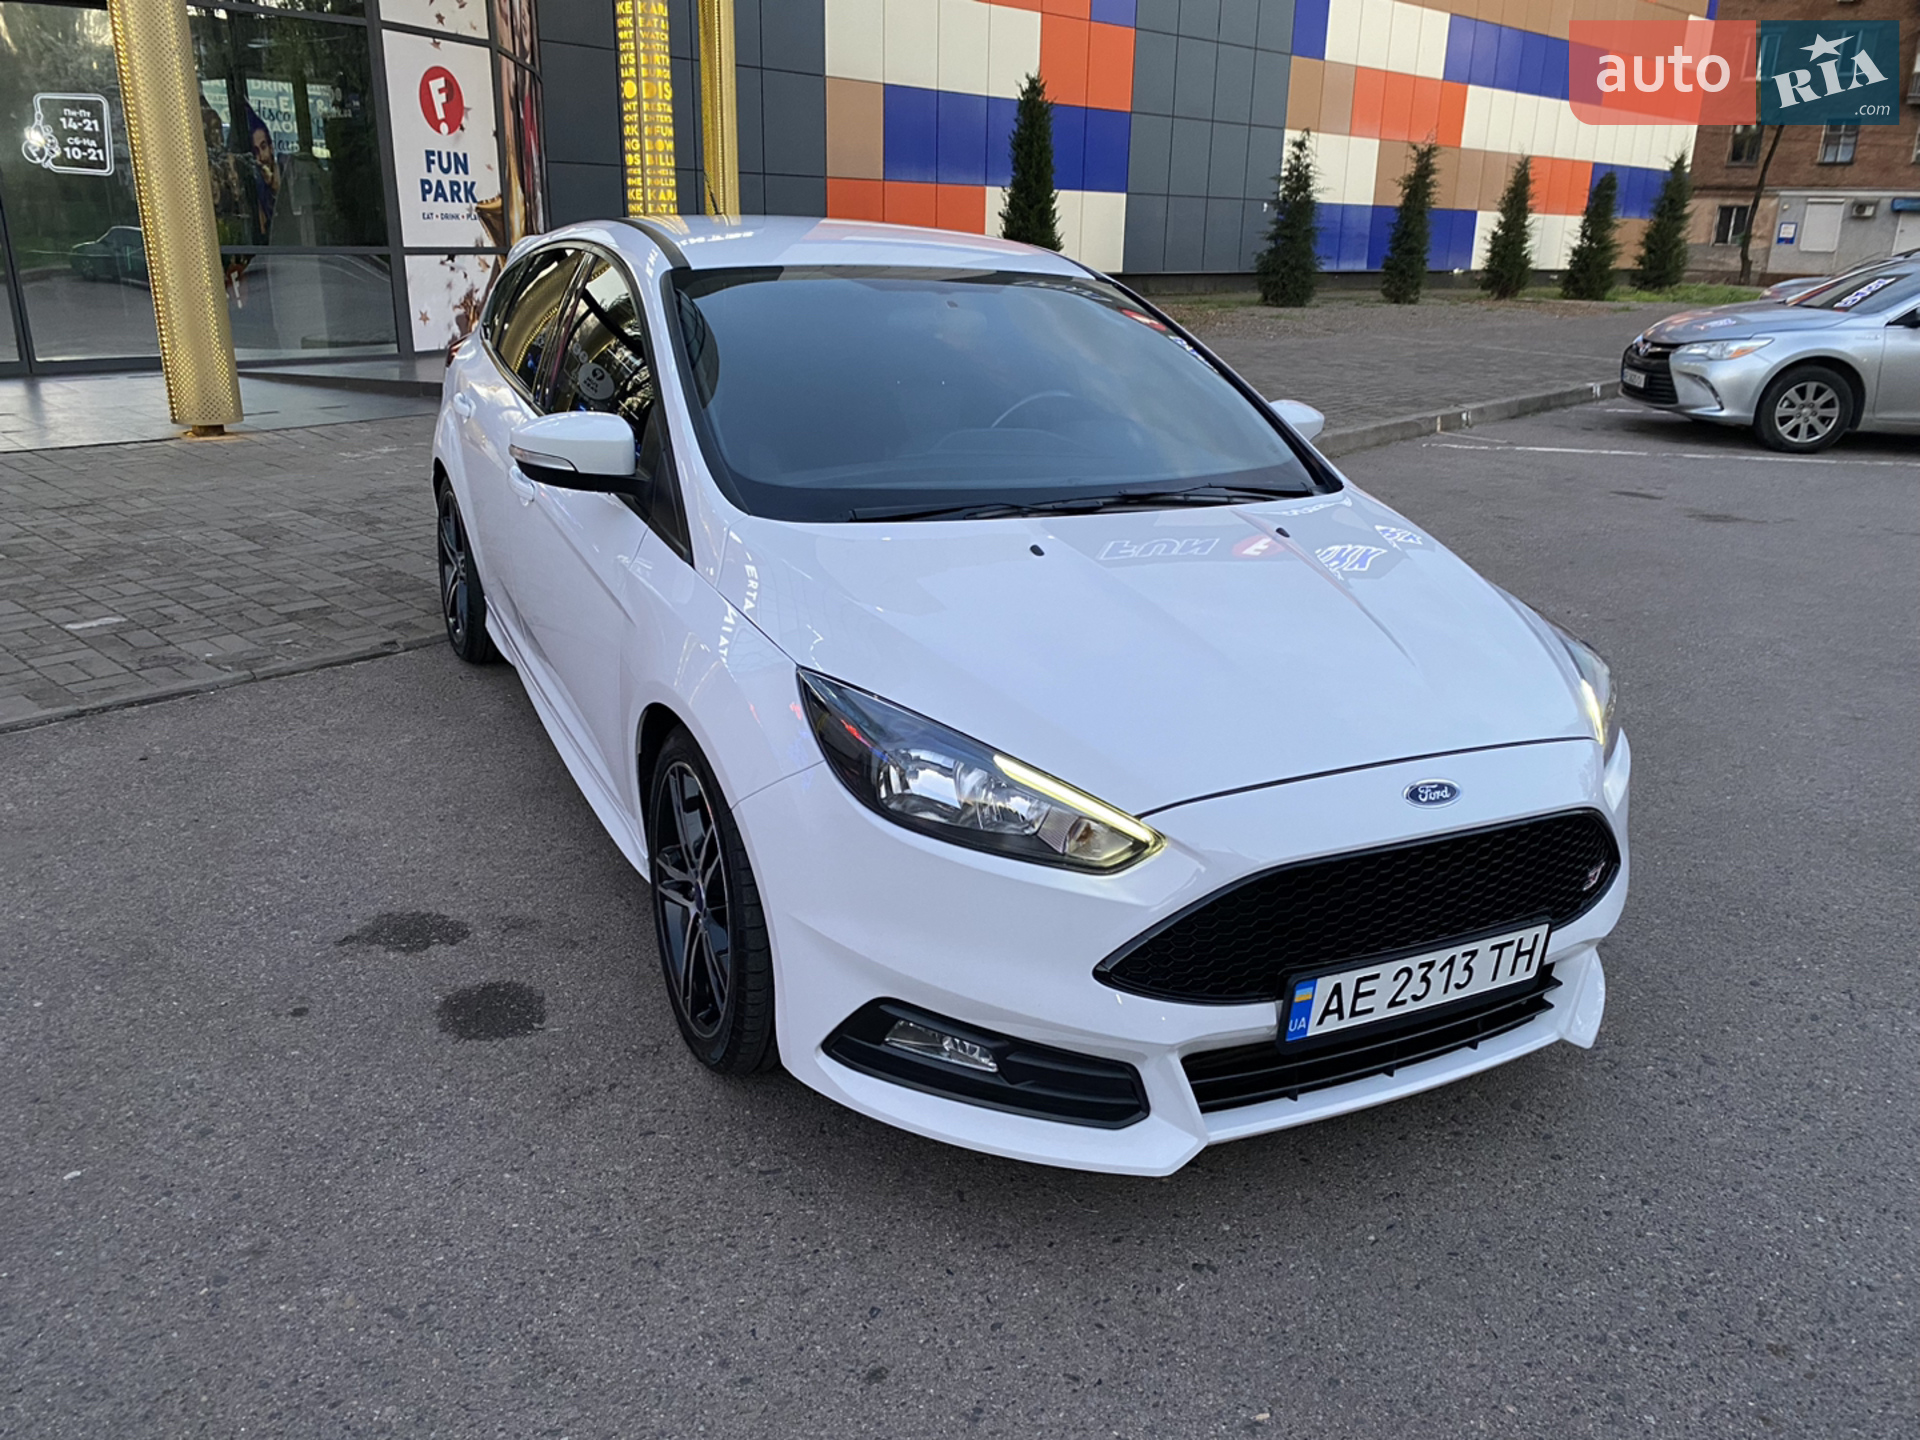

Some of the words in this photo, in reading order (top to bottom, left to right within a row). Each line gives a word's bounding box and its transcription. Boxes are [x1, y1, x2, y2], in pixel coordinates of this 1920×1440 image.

[60, 117, 100, 132] 14-21
[63, 147, 105, 161] 10-21
[425, 149, 470, 175] FUN
[420, 178, 478, 204] PARK
[466, 212, 478, 221] PLA
[1418, 783, 1452, 803] Ford
[1288, 1016, 1307, 1033] UA
[1316, 972, 1381, 1027] AE
[1386, 948, 1479, 1010] 2313
[1489, 932, 1541, 983] TH
